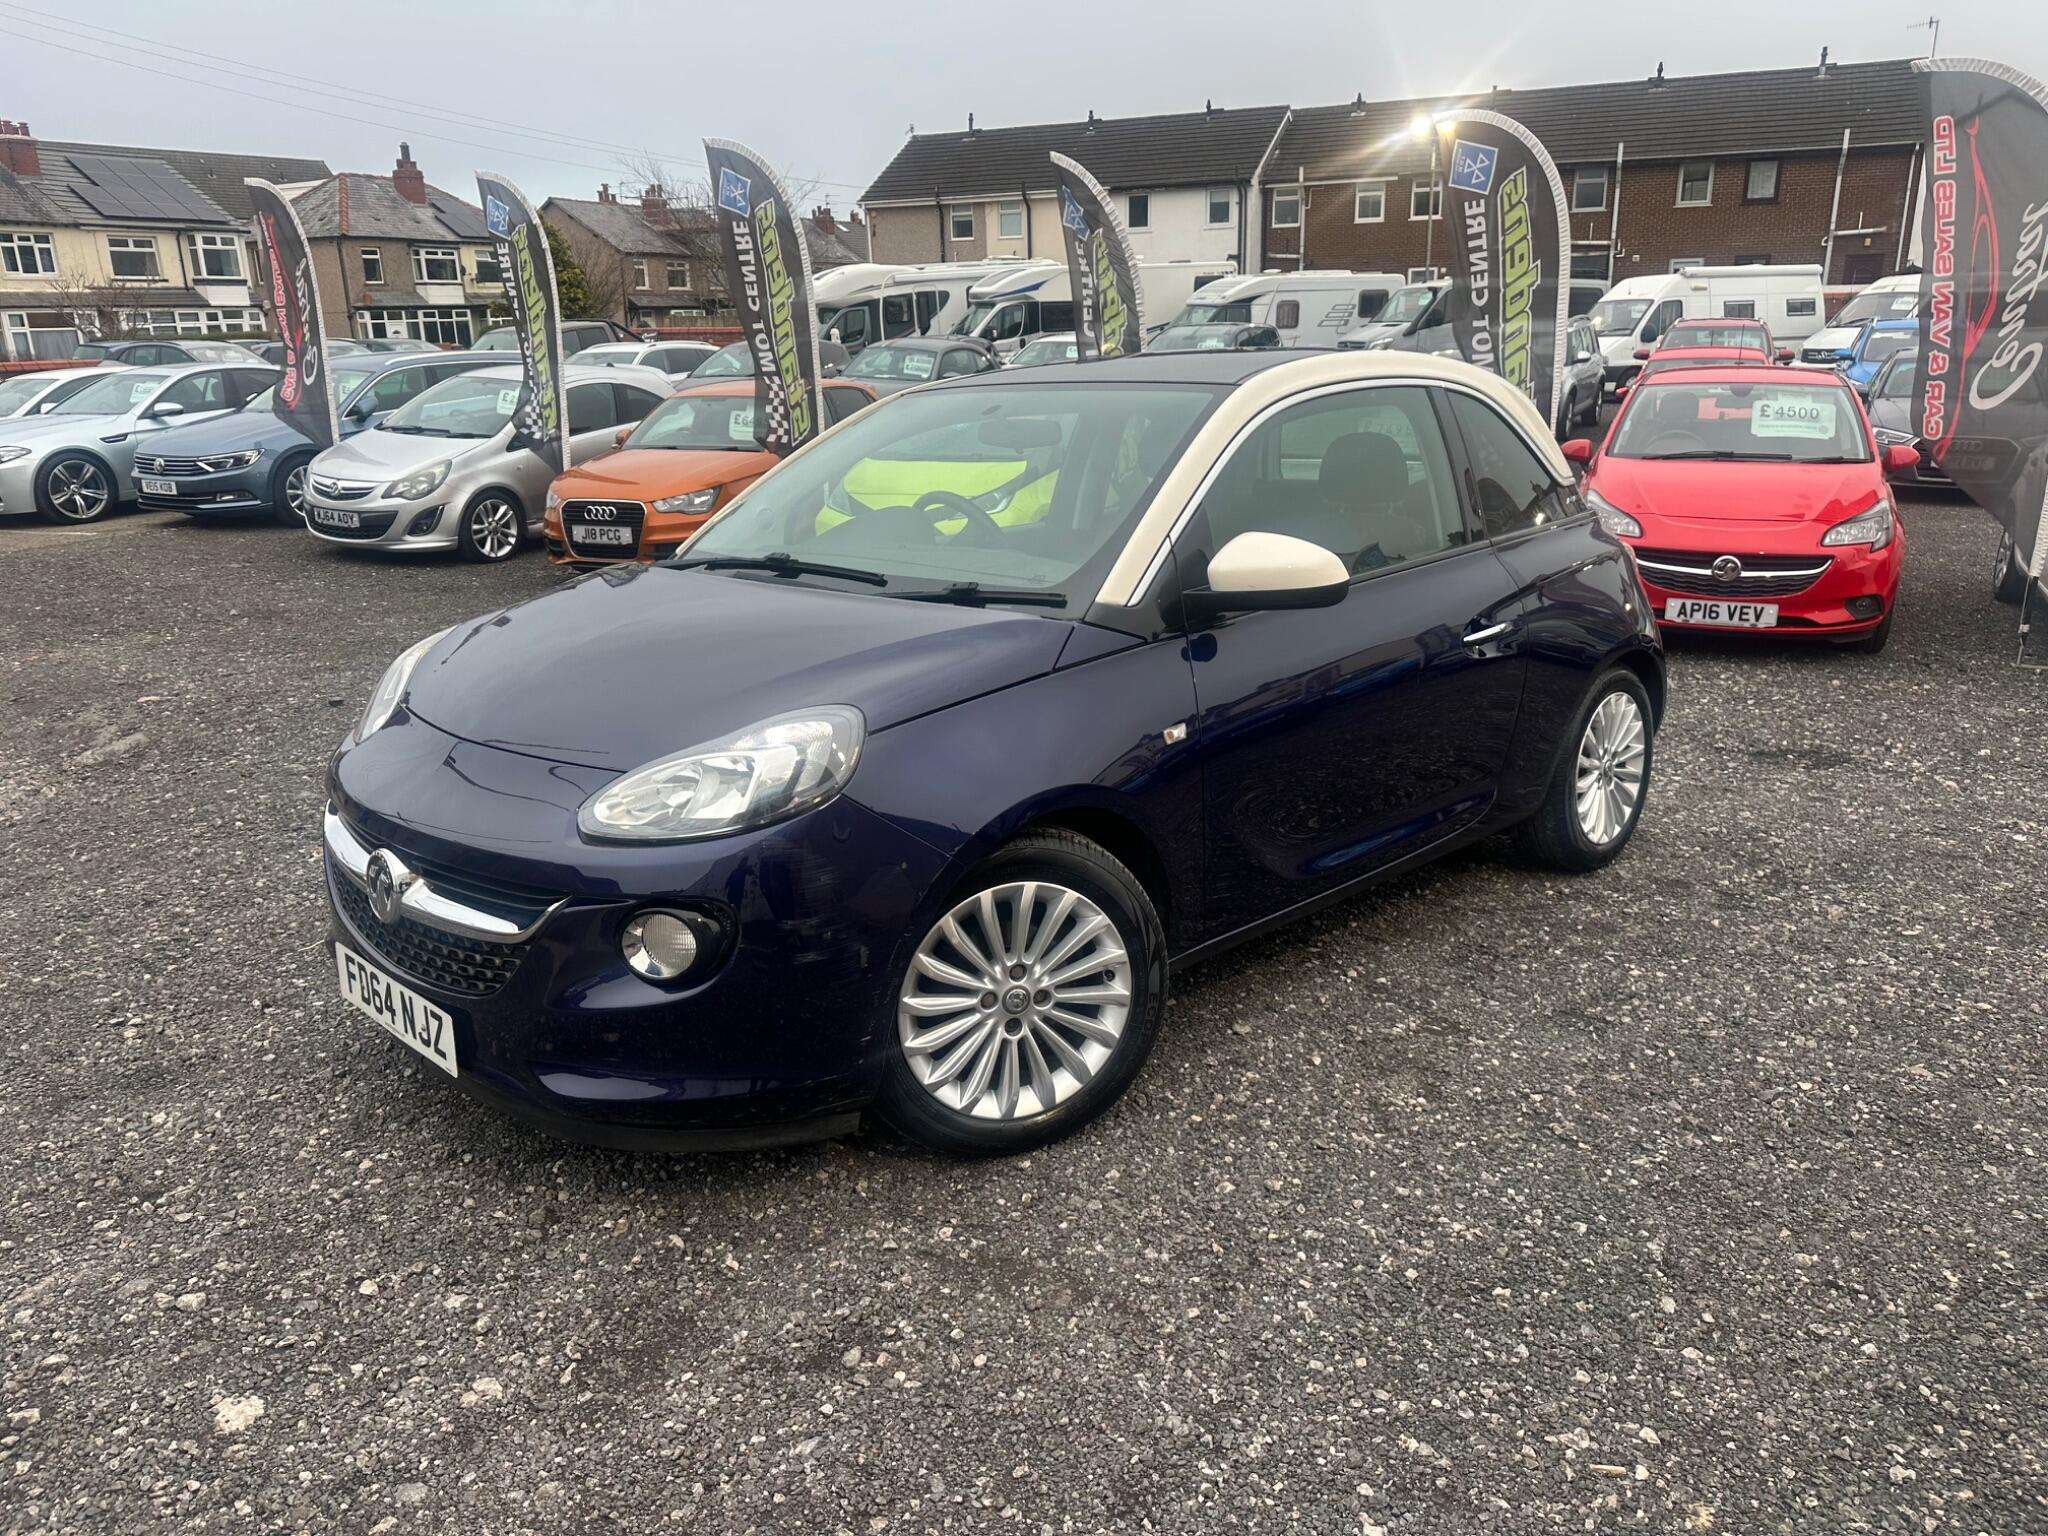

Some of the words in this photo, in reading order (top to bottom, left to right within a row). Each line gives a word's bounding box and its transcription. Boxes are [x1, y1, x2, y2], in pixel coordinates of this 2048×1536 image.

[582, 528, 597, 540] J18
[599, 528, 621, 541] PCG
[1676, 601, 1720, 620] AP16
[1727, 604, 1764, 622] VEV
[344, 952, 396, 1026] FD64
[400, 990, 447, 1061] NJZ
